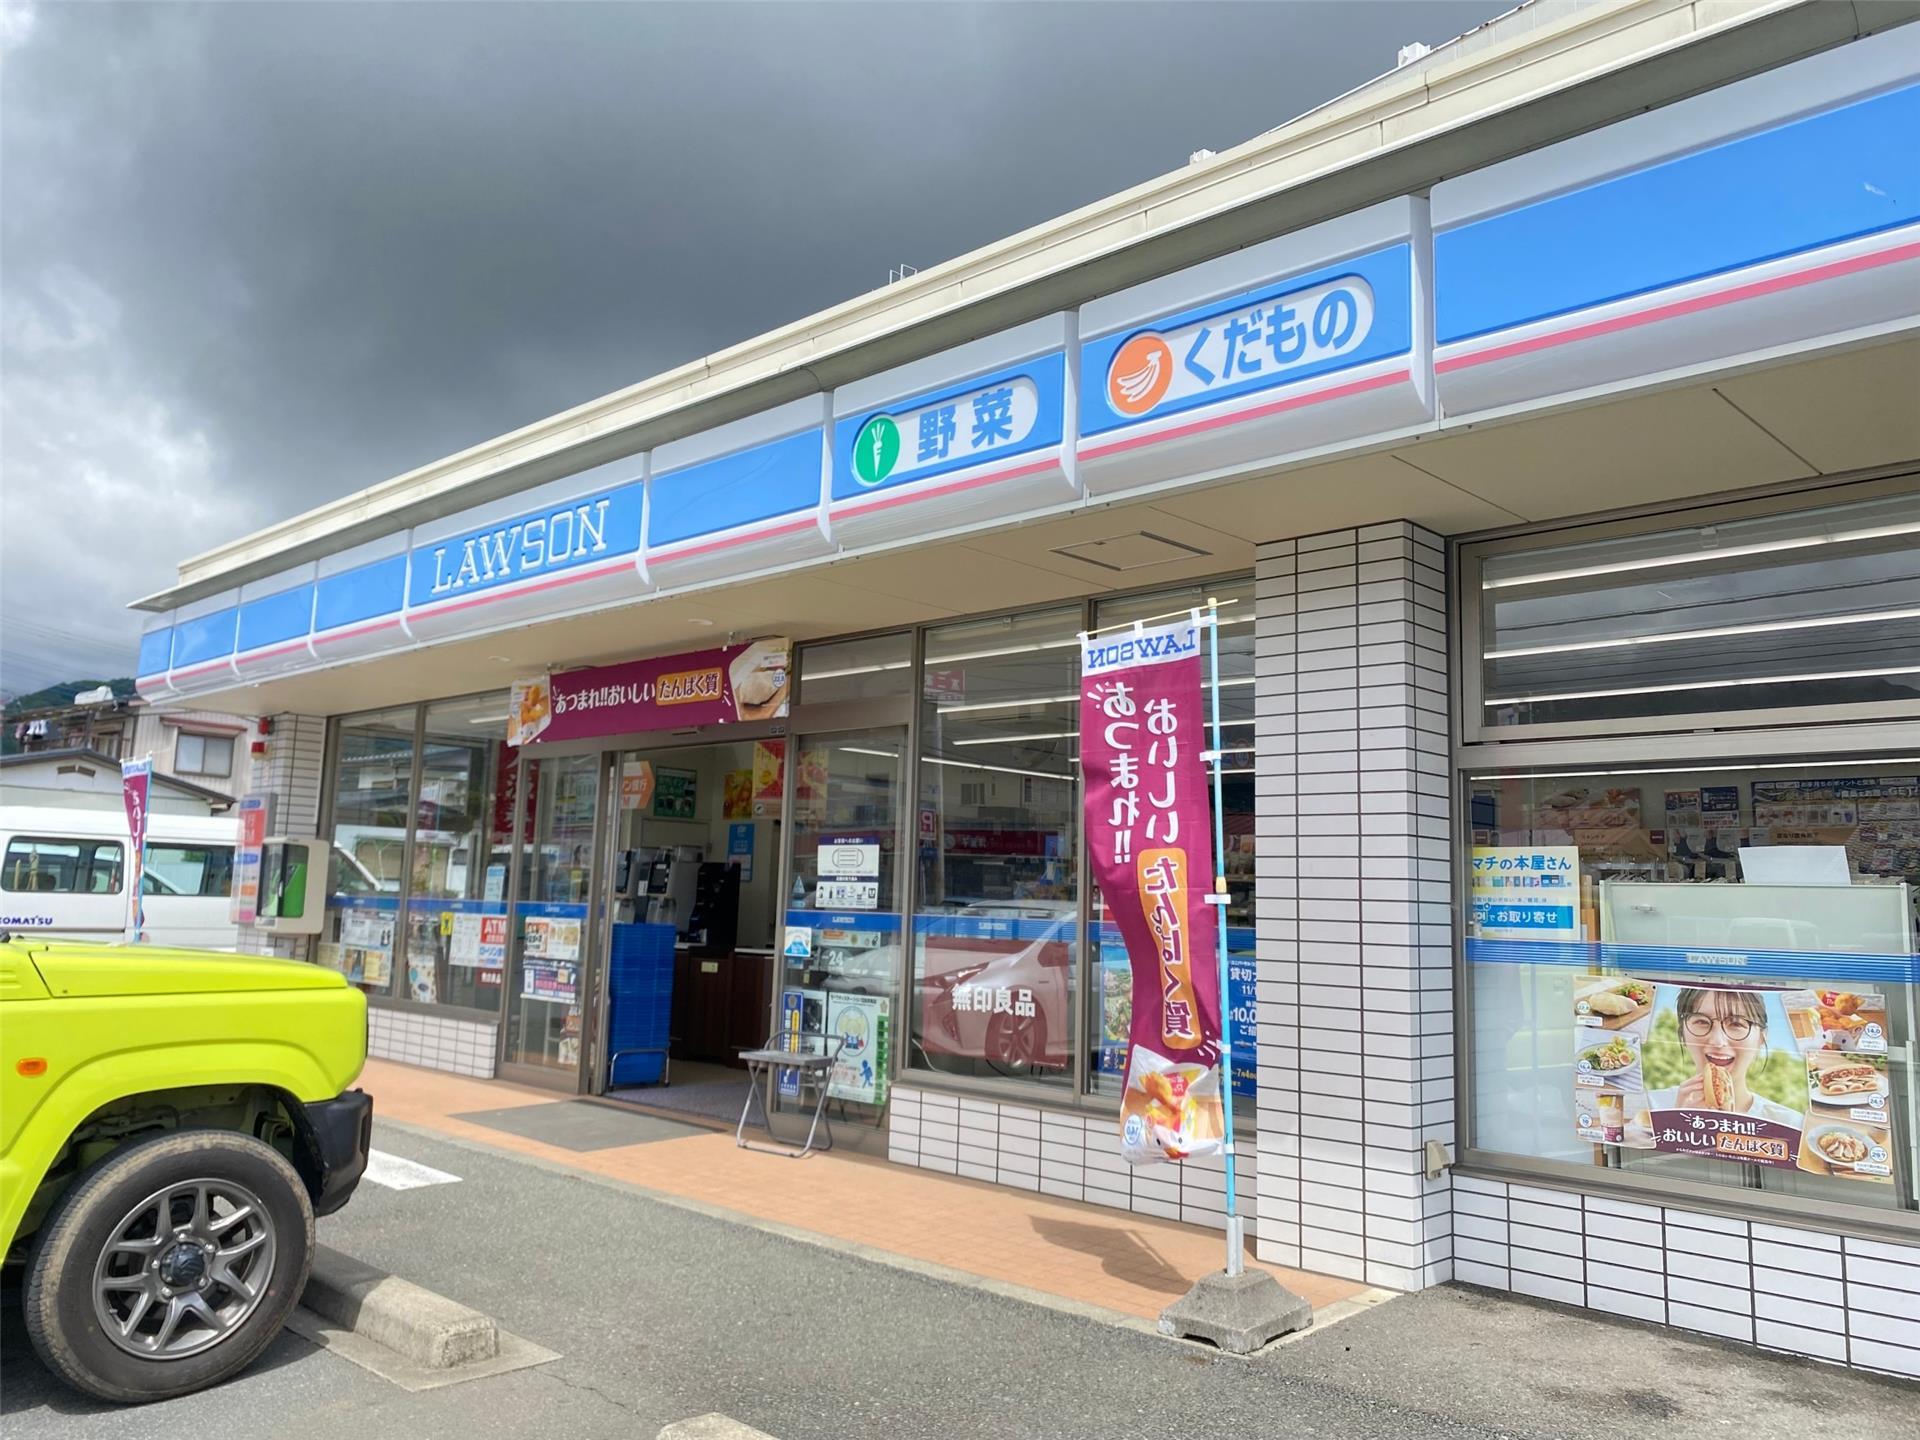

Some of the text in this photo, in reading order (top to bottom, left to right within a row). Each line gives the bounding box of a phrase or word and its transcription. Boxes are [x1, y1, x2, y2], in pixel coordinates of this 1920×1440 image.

[1184, 289, 1358, 387] くだもの
[917, 387, 1014, 463] 野菜
[431, 499, 612, 595] LAWSON
[1472, 855, 1572, 871] マチの本屋さん
[0, 916, 53, 926] OMATSU
[950, 981, 1036, 1018] 無印良品
[1662, 1128, 1717, 1147] おいしい
[1691, 1115, 1756, 1136] あつまれ!!
